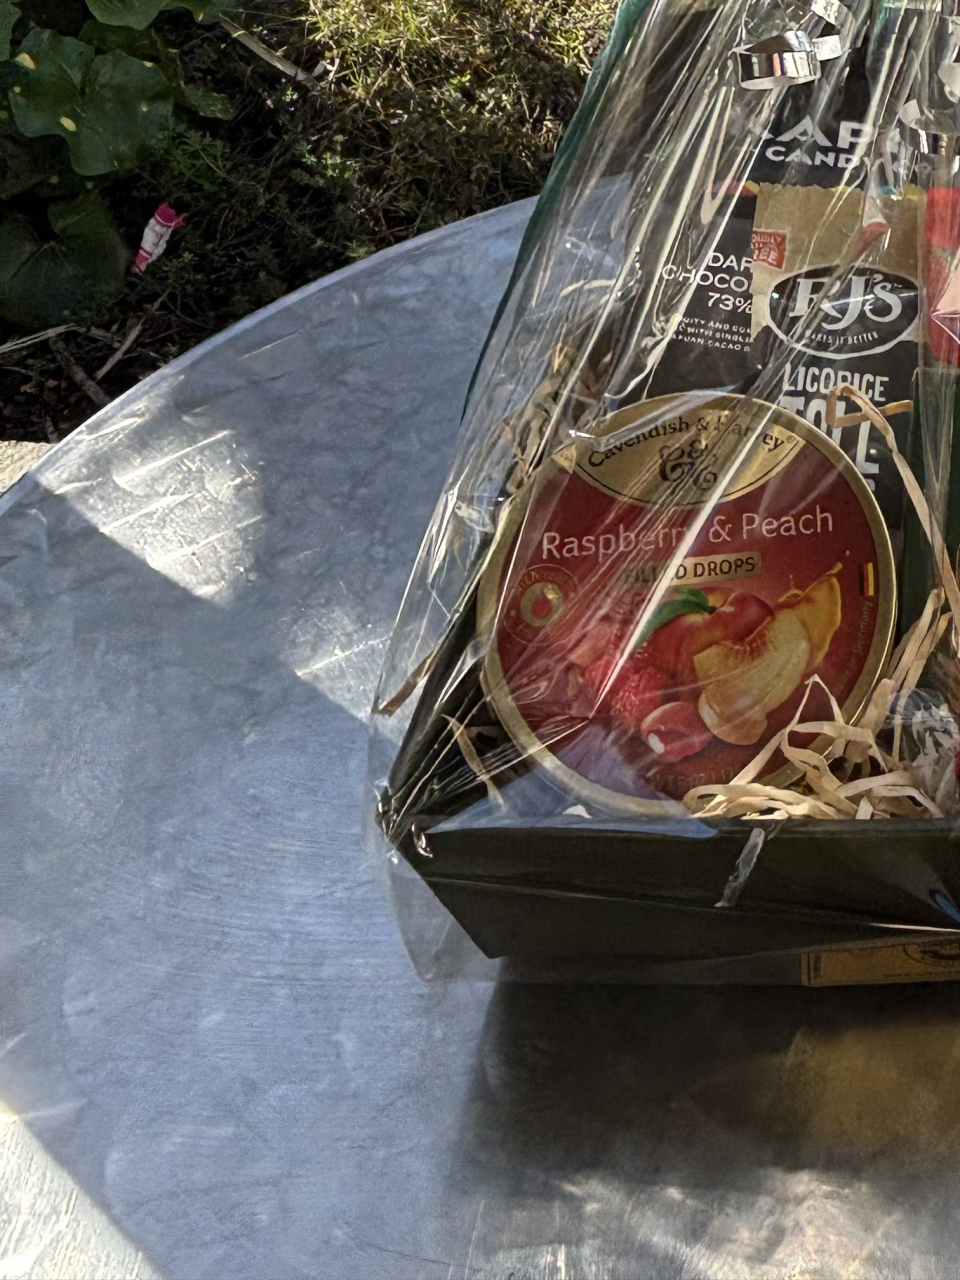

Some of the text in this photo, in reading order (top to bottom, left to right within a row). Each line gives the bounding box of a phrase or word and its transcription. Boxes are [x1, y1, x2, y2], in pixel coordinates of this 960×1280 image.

[707, 252, 753, 272] DAR
[661, 265, 749, 292] CHOCO
[708, 292, 752, 314] 73%
[782, 362, 890, 402] LICORICE
[588, 416, 690, 467] Cavendish
[715, 415, 785, 453] arey
[541, 505, 834, 561] Raspberr & Peach
[693, 556, 756, 578] DROPS
